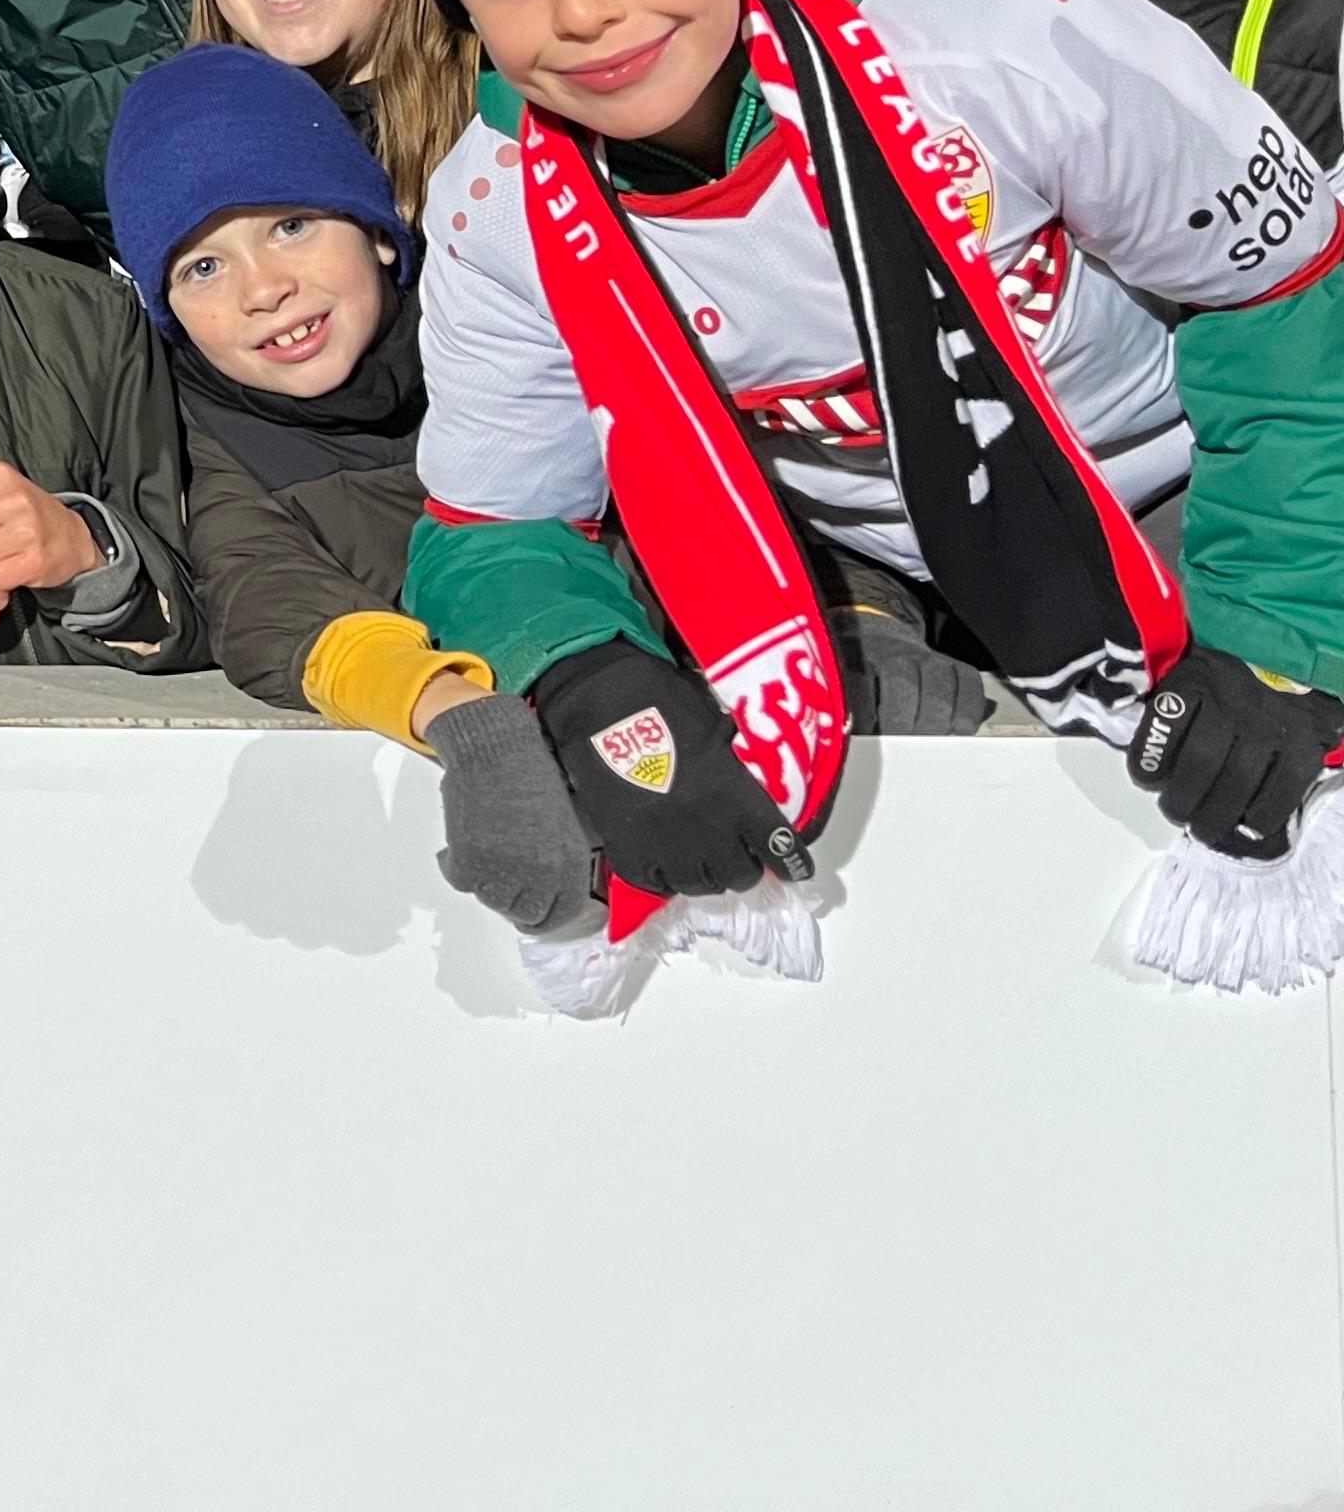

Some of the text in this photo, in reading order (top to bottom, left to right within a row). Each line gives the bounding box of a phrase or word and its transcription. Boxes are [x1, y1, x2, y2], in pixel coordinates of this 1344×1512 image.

[837, 17, 986, 264] LEAGUE
[1228, 143, 1316, 272] solar
[1139, 716, 1173, 773] JAKO
